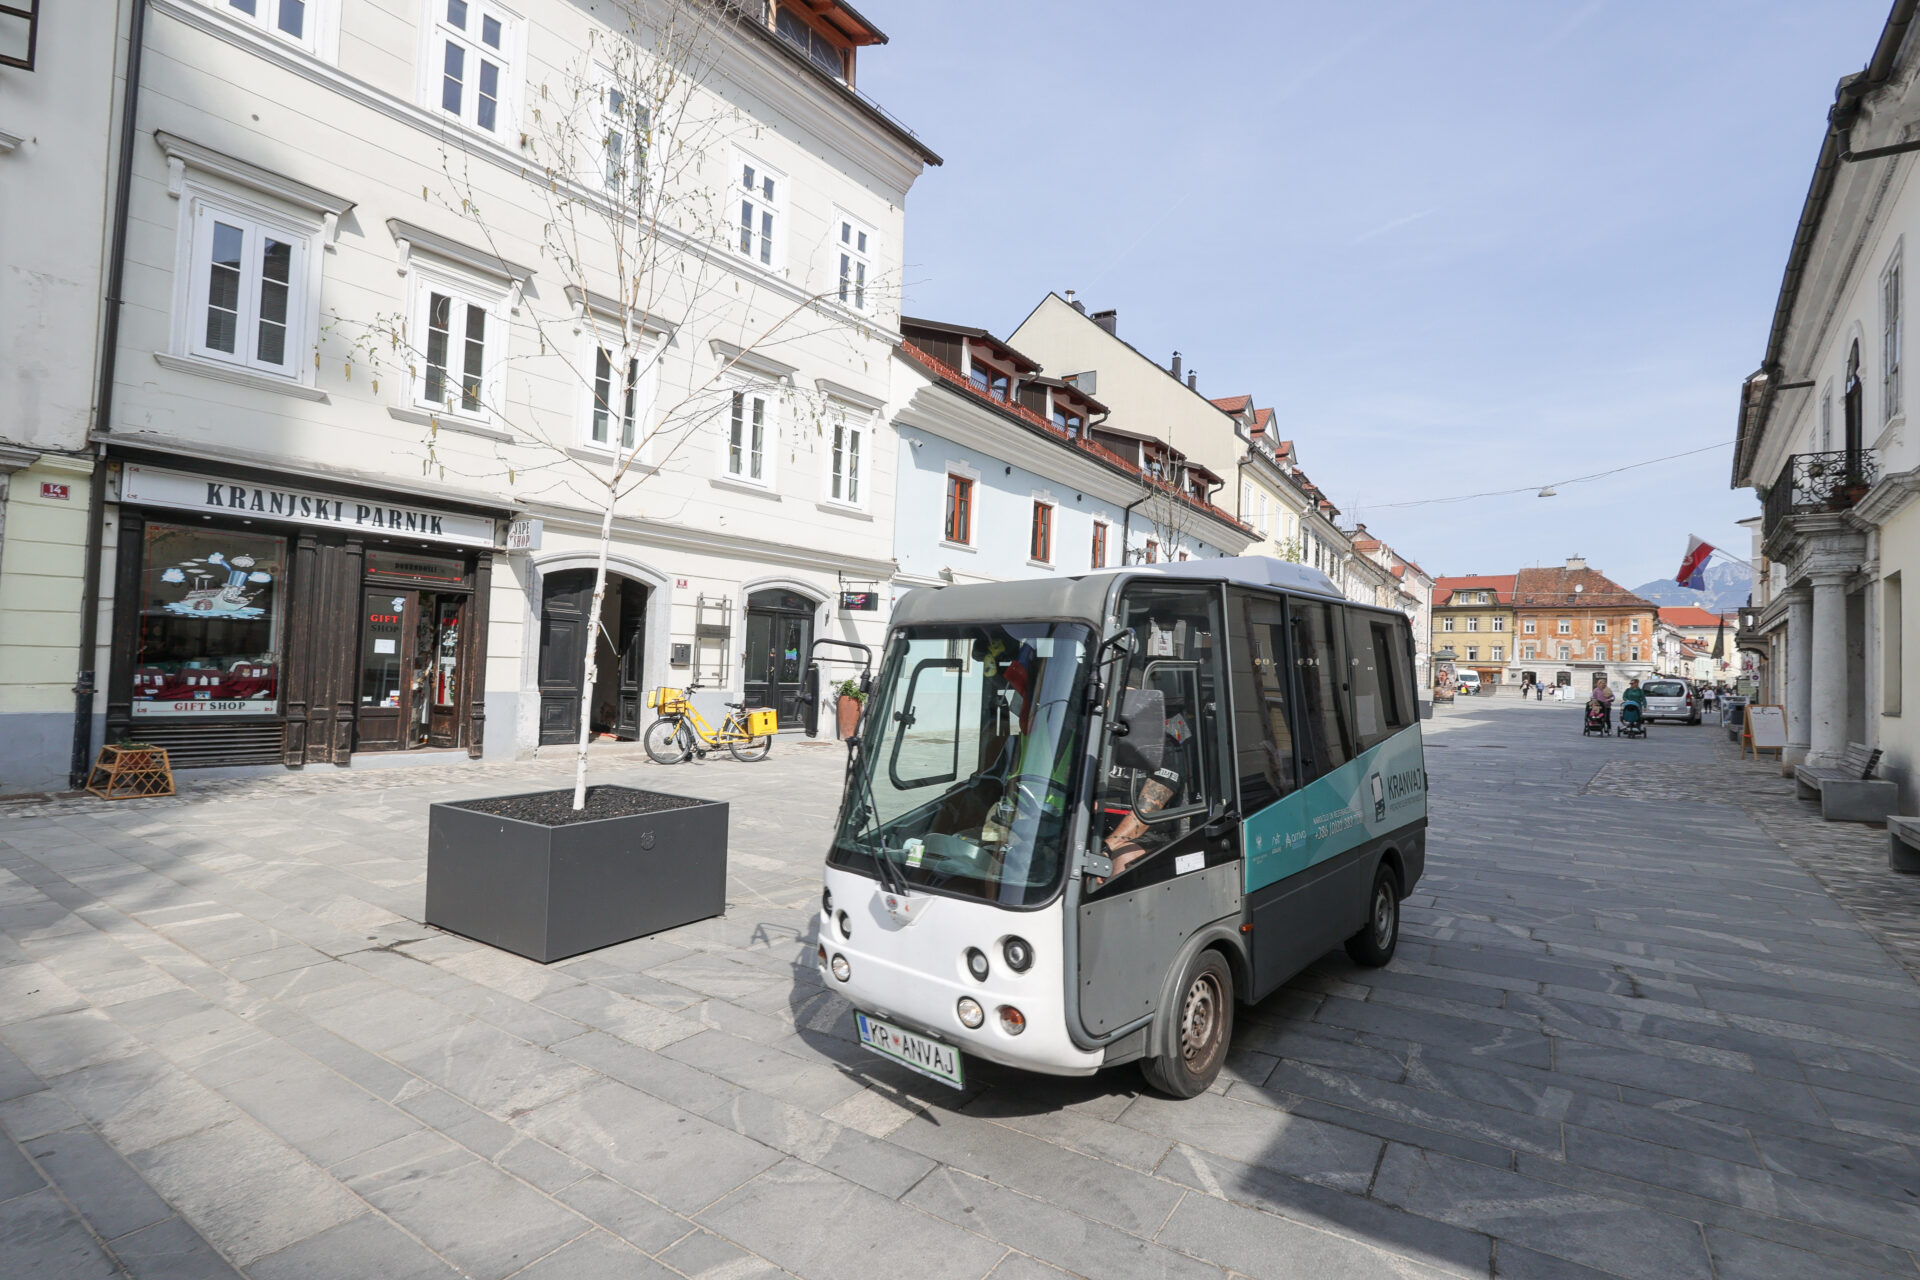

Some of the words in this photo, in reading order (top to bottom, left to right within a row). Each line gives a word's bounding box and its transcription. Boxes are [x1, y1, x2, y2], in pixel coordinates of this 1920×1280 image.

[206, 482, 343, 522] KRANJSKI
[355, 504, 443, 535] PARNIK
[513, 535, 530, 548] SHOP
[370, 614, 399, 623] GIFT
[370, 624, 399, 633] SHOP
[174, 702, 207, 711] GIFT
[209, 702, 246, 710] SHOP
[1387, 768, 1422, 800] KRANVAJ
[870, 1022, 890, 1049] KR
[903, 1034, 954, 1074] ANVAJ
